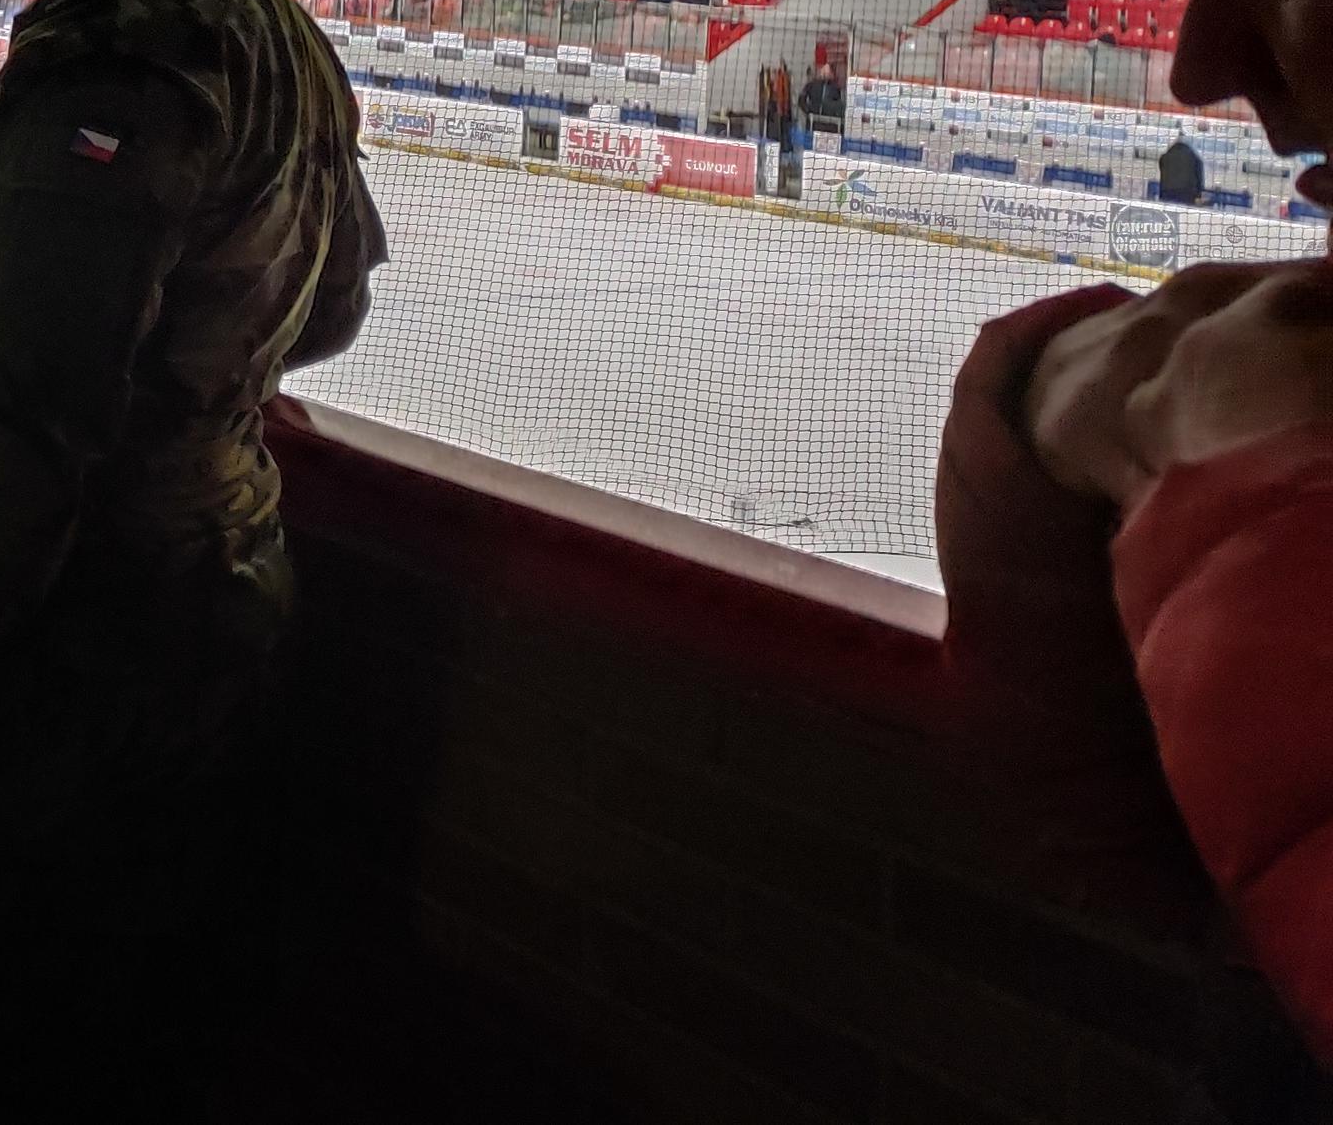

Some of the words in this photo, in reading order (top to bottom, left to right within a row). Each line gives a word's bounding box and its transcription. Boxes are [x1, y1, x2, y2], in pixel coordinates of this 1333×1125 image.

[568, 127, 642, 158] SELM
[566, 150, 639, 175] MORAVA
[686, 158, 739, 175] OLOMOUC
[849, 198, 931, 224] Olomoucký
[934, 211, 959, 231] kraj
[981, 195, 1060, 222] VALIANT
[1063, 209, 1109, 230] TMS
